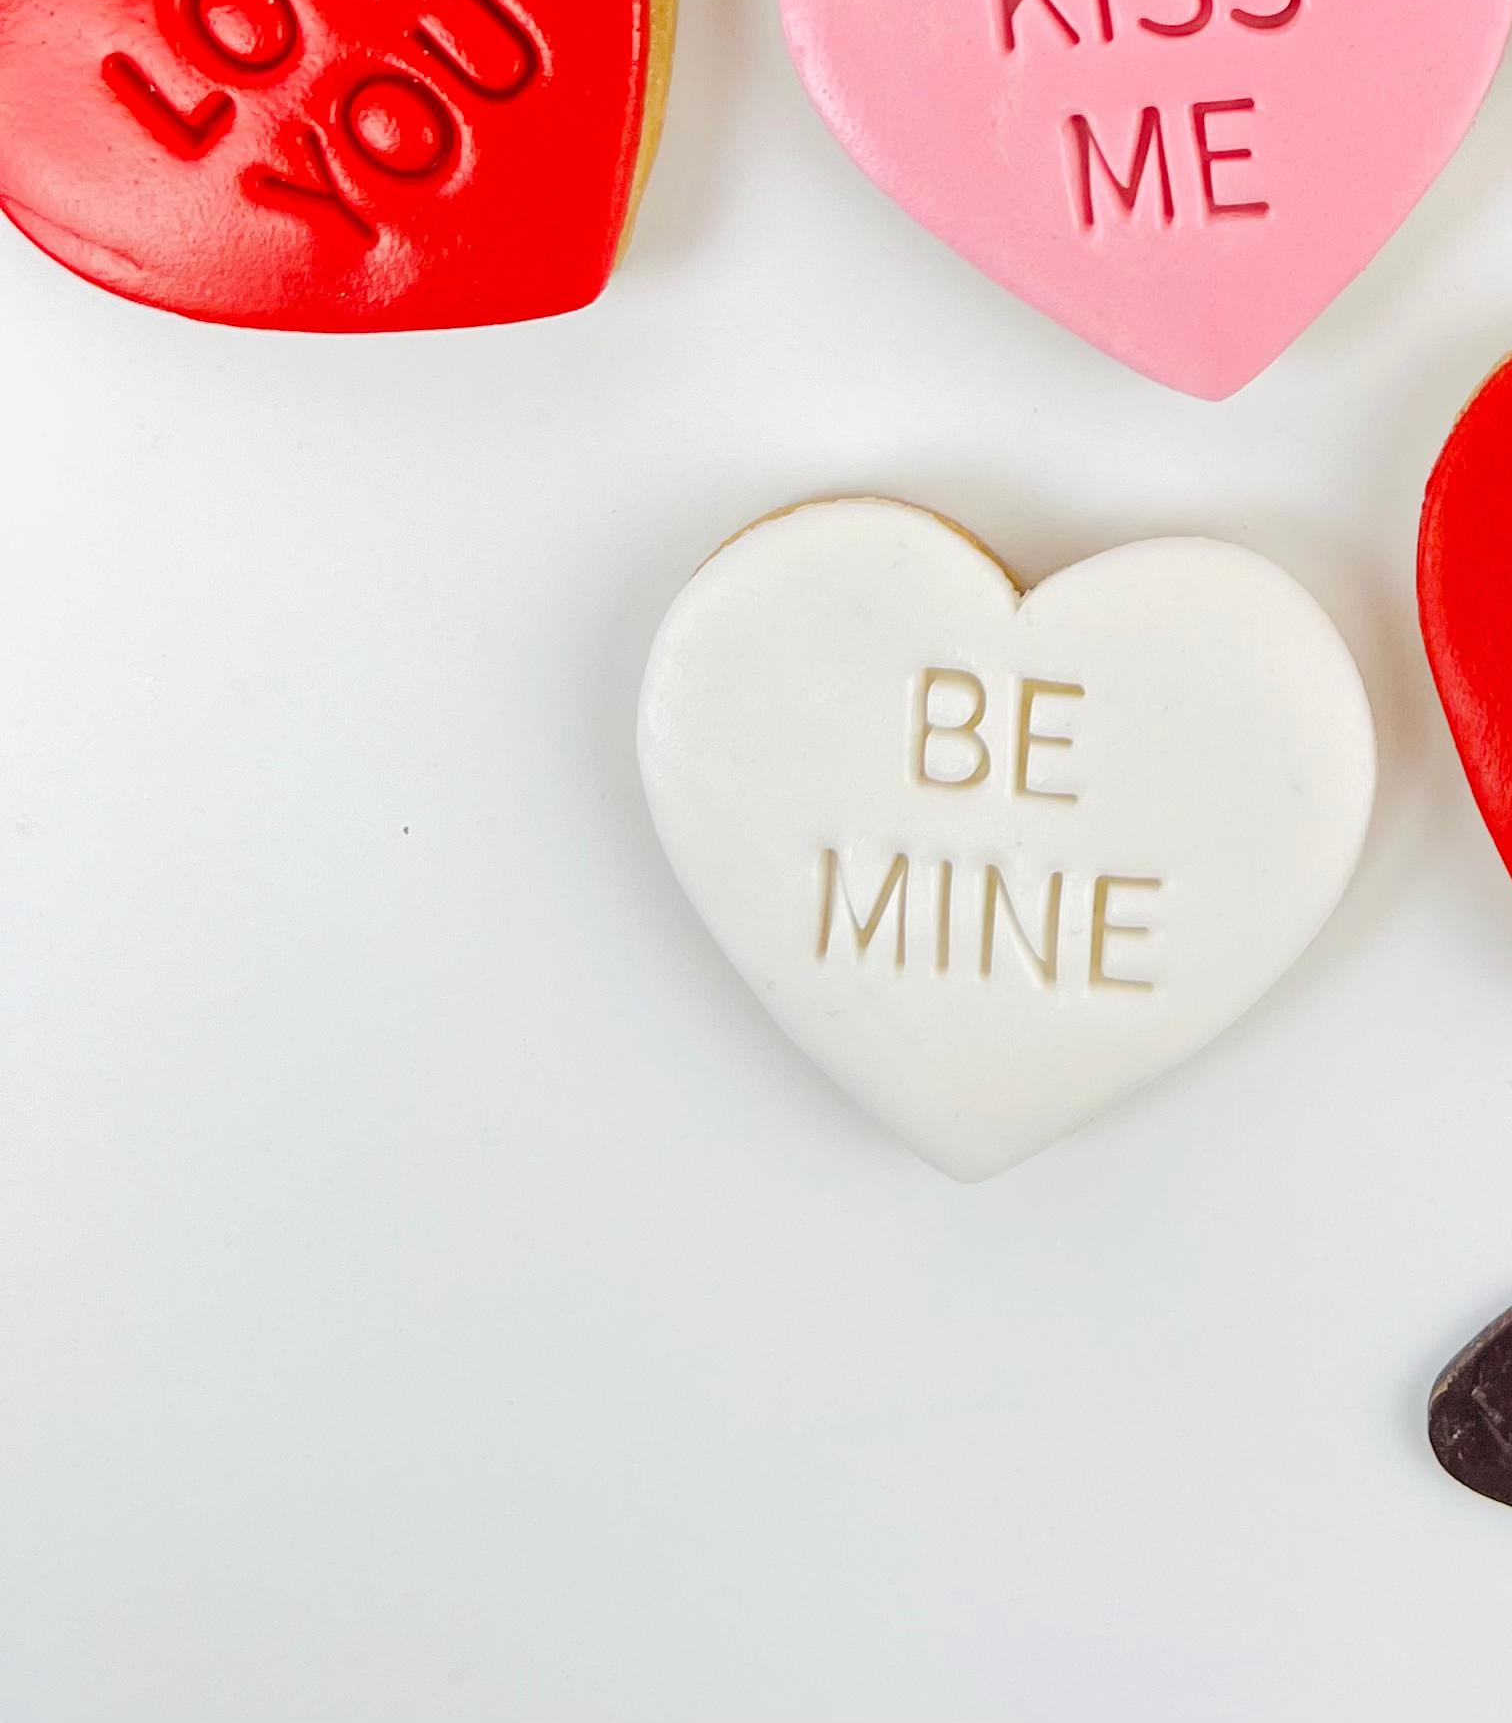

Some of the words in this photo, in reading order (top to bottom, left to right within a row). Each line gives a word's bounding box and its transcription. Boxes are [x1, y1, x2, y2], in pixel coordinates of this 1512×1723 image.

[1069, 97, 1270, 227] ME
[916, 667, 1085, 804] BE
[815, 848, 1163, 993] MINE
